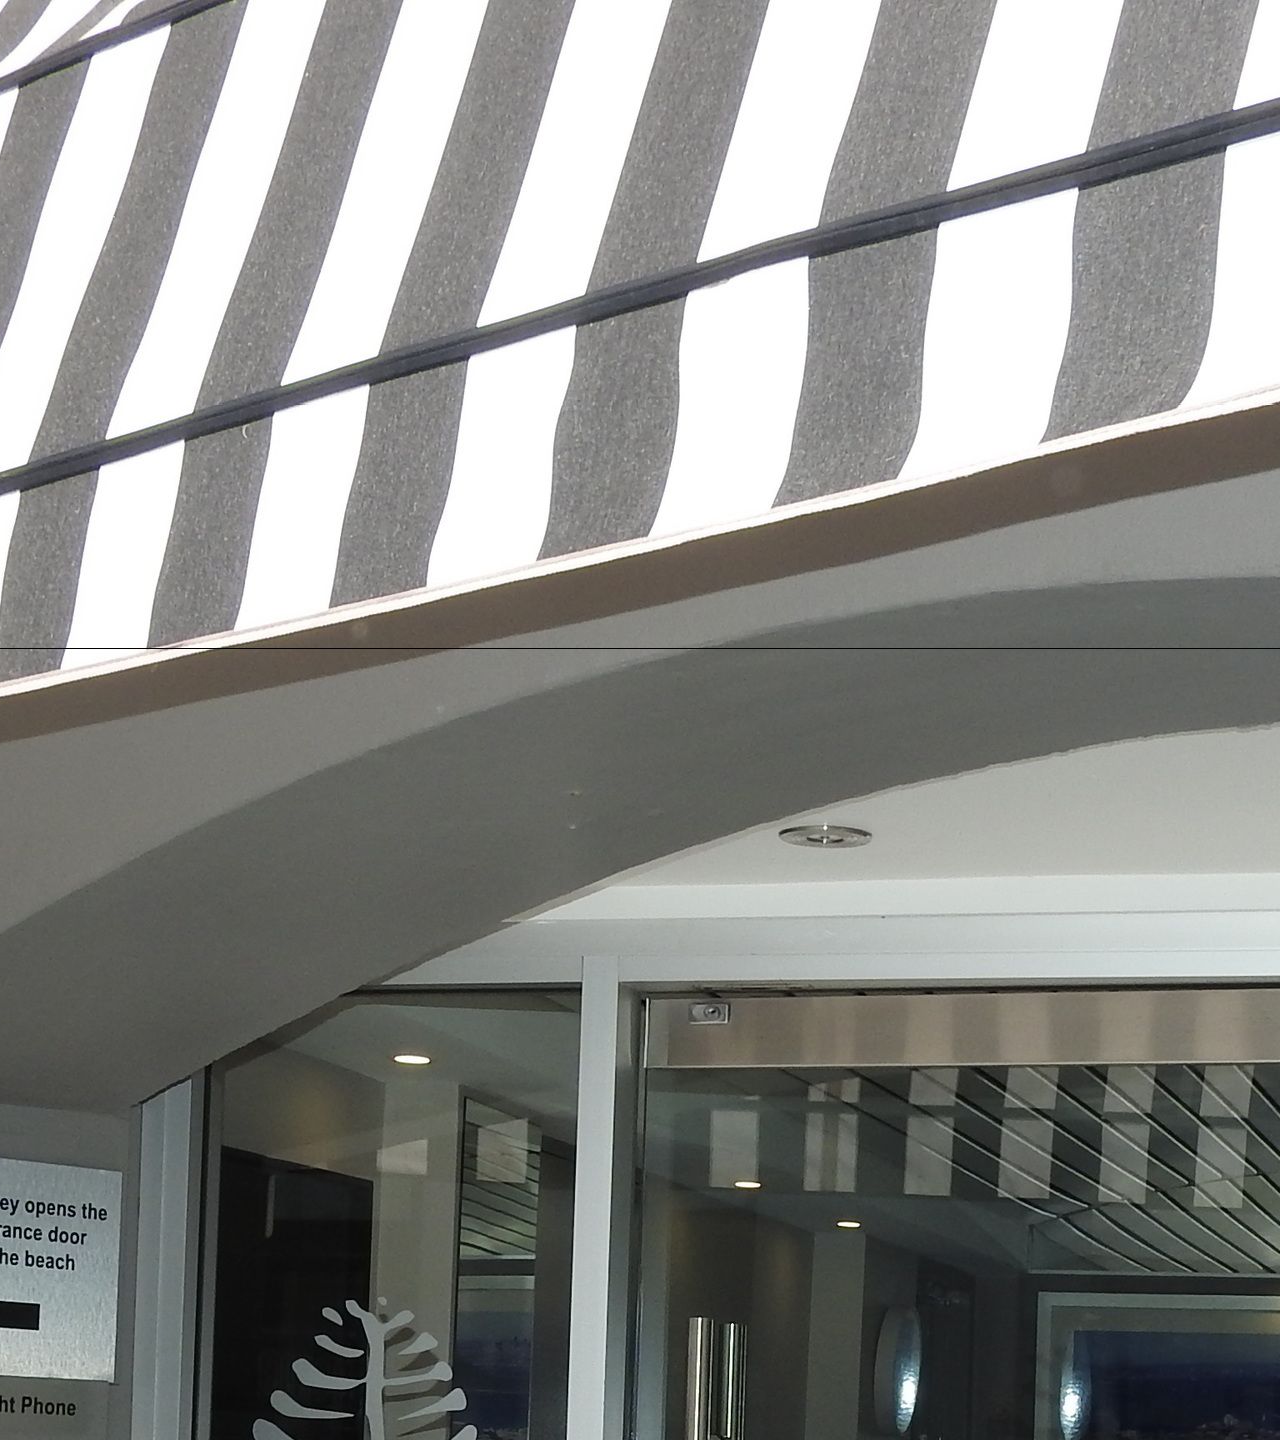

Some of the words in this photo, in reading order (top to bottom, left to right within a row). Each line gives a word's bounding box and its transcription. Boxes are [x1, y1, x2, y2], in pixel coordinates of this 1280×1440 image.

[24, 1199, 77, 1218] opens
[81, 1202, 108, 1221] the
[47, 1226, 88, 1246] door
[24, 1251, 76, 1271] beach
[20, 1396, 77, 1416] Phone
